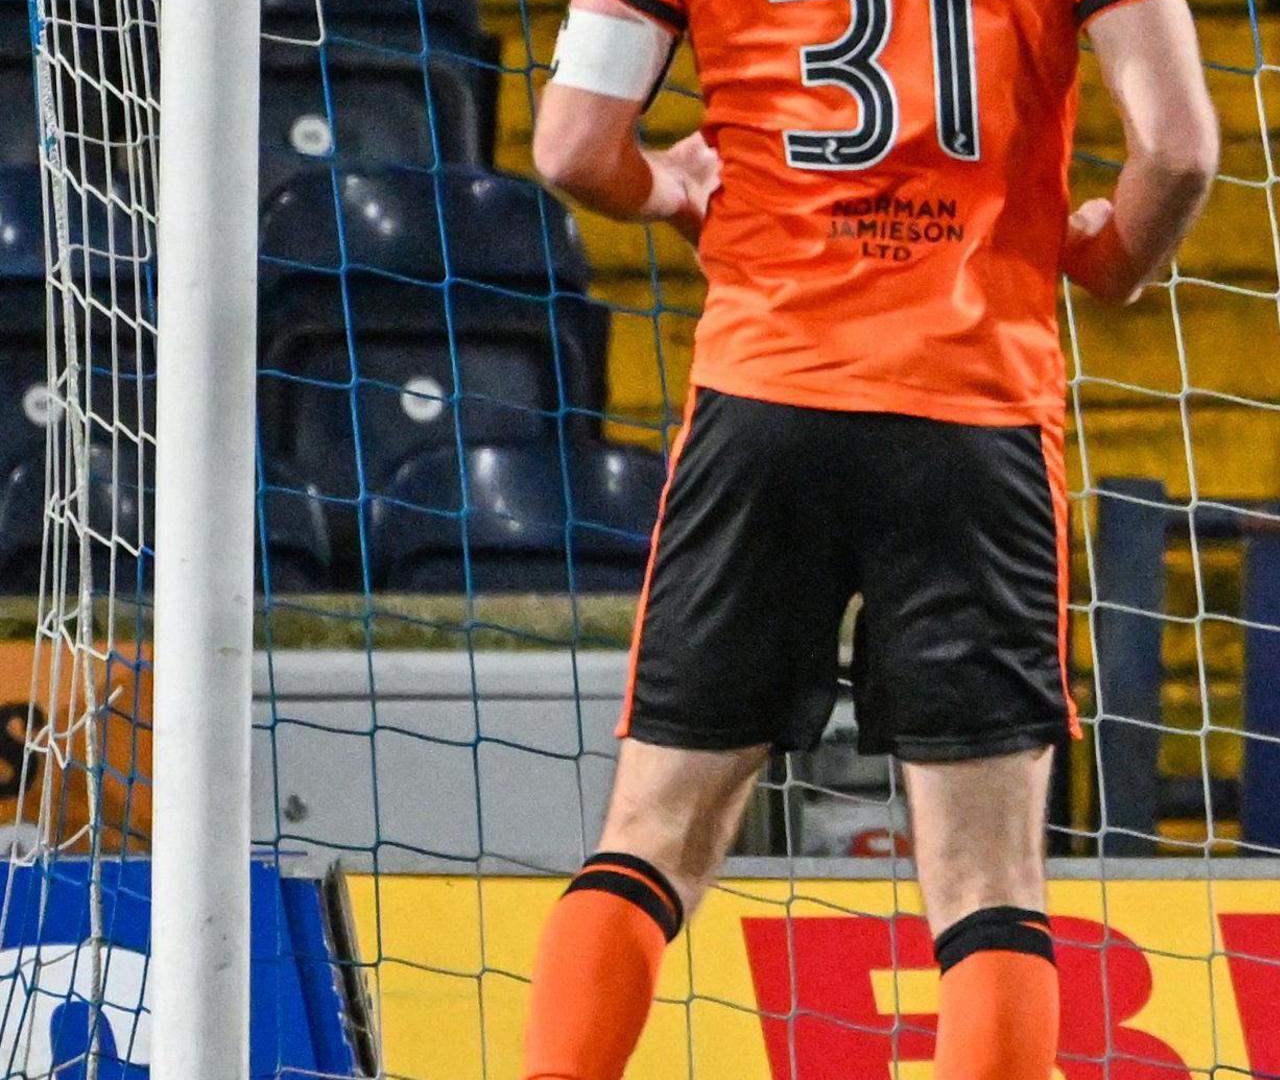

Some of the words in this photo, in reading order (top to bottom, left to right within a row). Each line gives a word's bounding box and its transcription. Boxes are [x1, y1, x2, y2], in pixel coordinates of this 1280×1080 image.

[832, 197, 957, 219] NORMAN
[829, 219, 964, 243] JAMIESON
[862, 242, 911, 261] LTD
